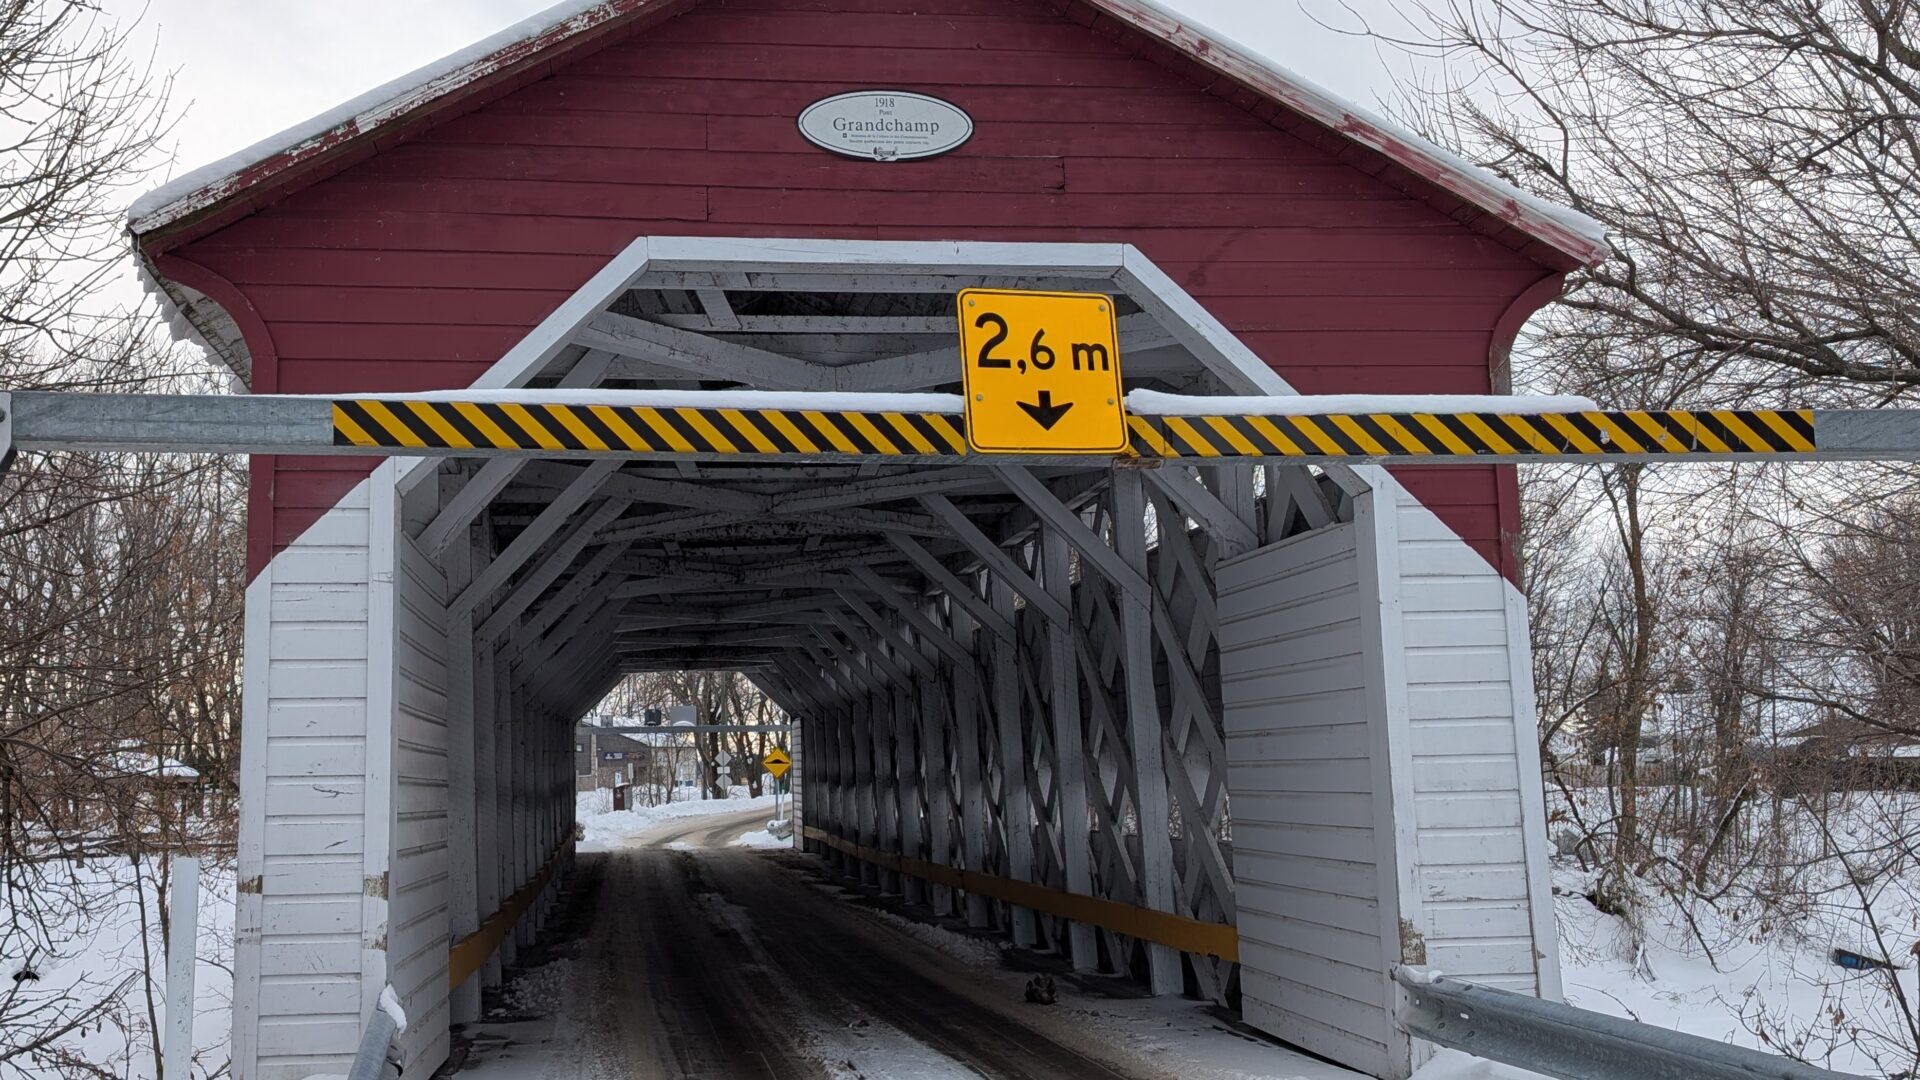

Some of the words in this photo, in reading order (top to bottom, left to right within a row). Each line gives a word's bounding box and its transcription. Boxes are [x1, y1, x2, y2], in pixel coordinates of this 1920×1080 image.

[875, 97, 895, 108] 1918
[833, 117, 940, 135] Grandchamp
[975, 312, 1056, 375] 2,6
[1071, 343, 1110, 371] m
